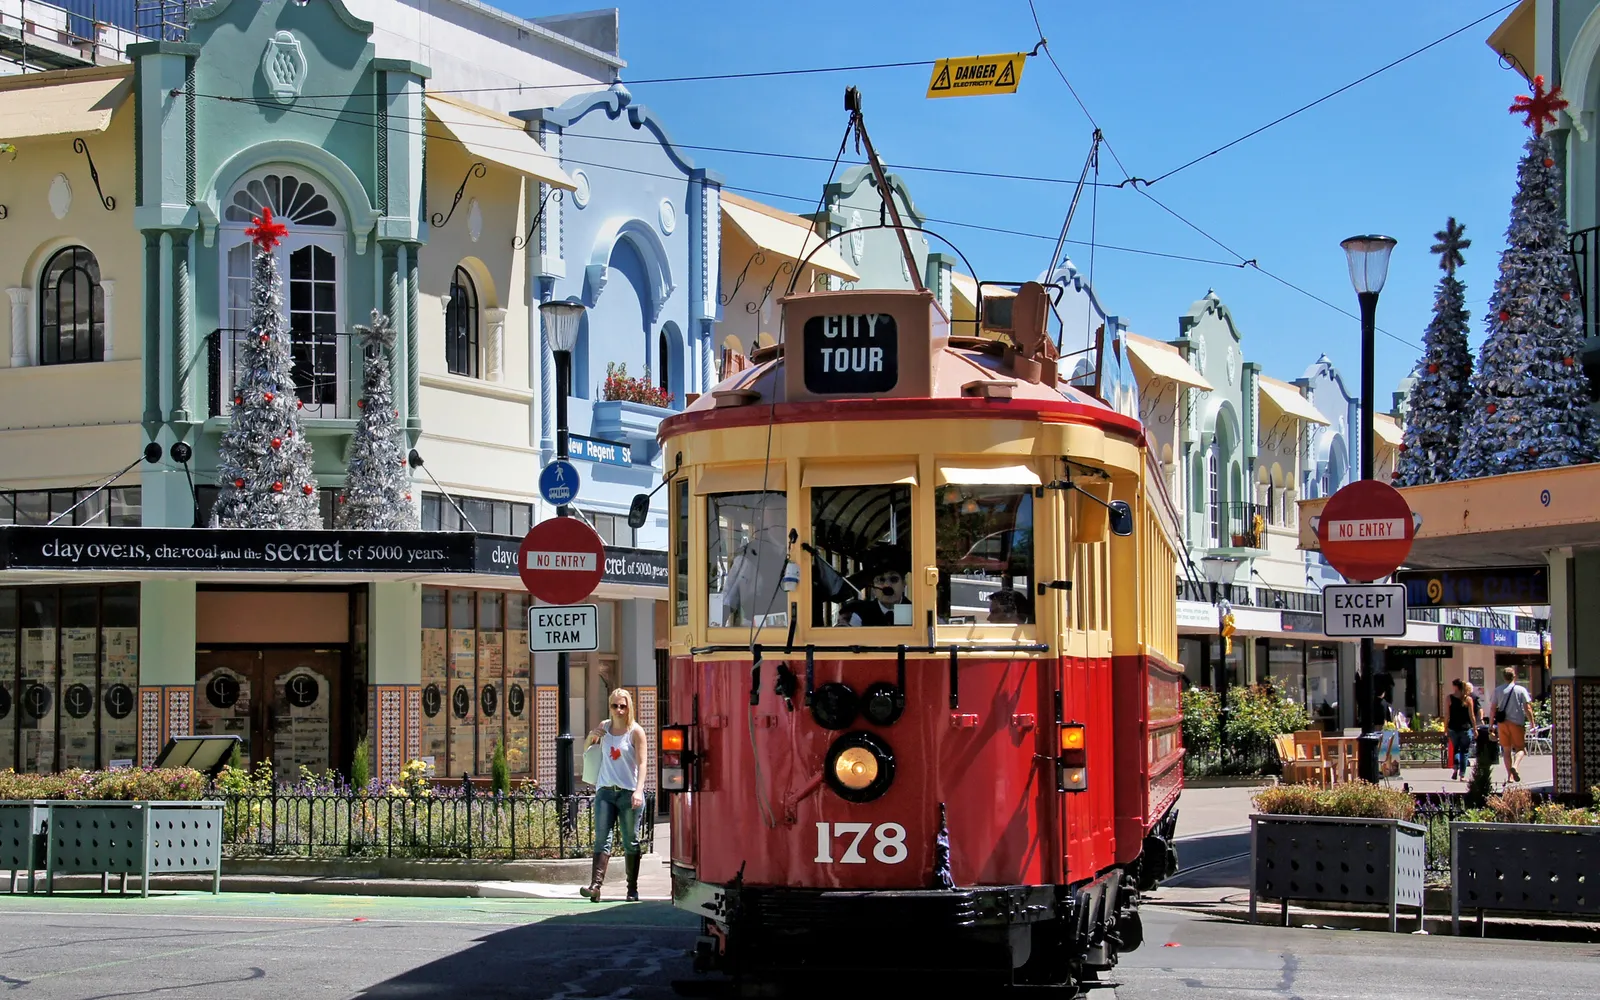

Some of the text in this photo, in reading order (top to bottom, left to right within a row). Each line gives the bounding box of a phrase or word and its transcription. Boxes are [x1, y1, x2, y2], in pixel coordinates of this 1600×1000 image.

[955, 64, 997, 80] DANGER
[953, 80, 994, 88] ELECTRICITY
[824, 314, 880, 338] CITY
[820, 347, 883, 372] TOUR
[587, 440, 615, 462] Regent
[622, 447, 631, 463] St
[1339, 522, 1393, 537] NO ENTRY
[42, 538, 84, 562] clay
[155, 544, 218, 559] charcoal
[220, 548, 241, 559] and
[243, 547, 262, 559] the
[265, 540, 343, 562] secret
[348, 545, 364, 560] of
[367, 545, 403, 560] 5000
[492, 545, 513, 568] clay
[604, 556, 627, 576] cret
[627, 561, 636, 575] of
[636, 562, 651, 577] 5000
[536, 554, 586, 568] NO ENTRY
[1335, 594, 1393, 609] EXCEPT
[538, 613, 587, 627] EXCEPT
[1343, 614, 1385, 628] TRAM
[545, 630, 580, 644] TRAM
[814, 822, 908, 864] 178
